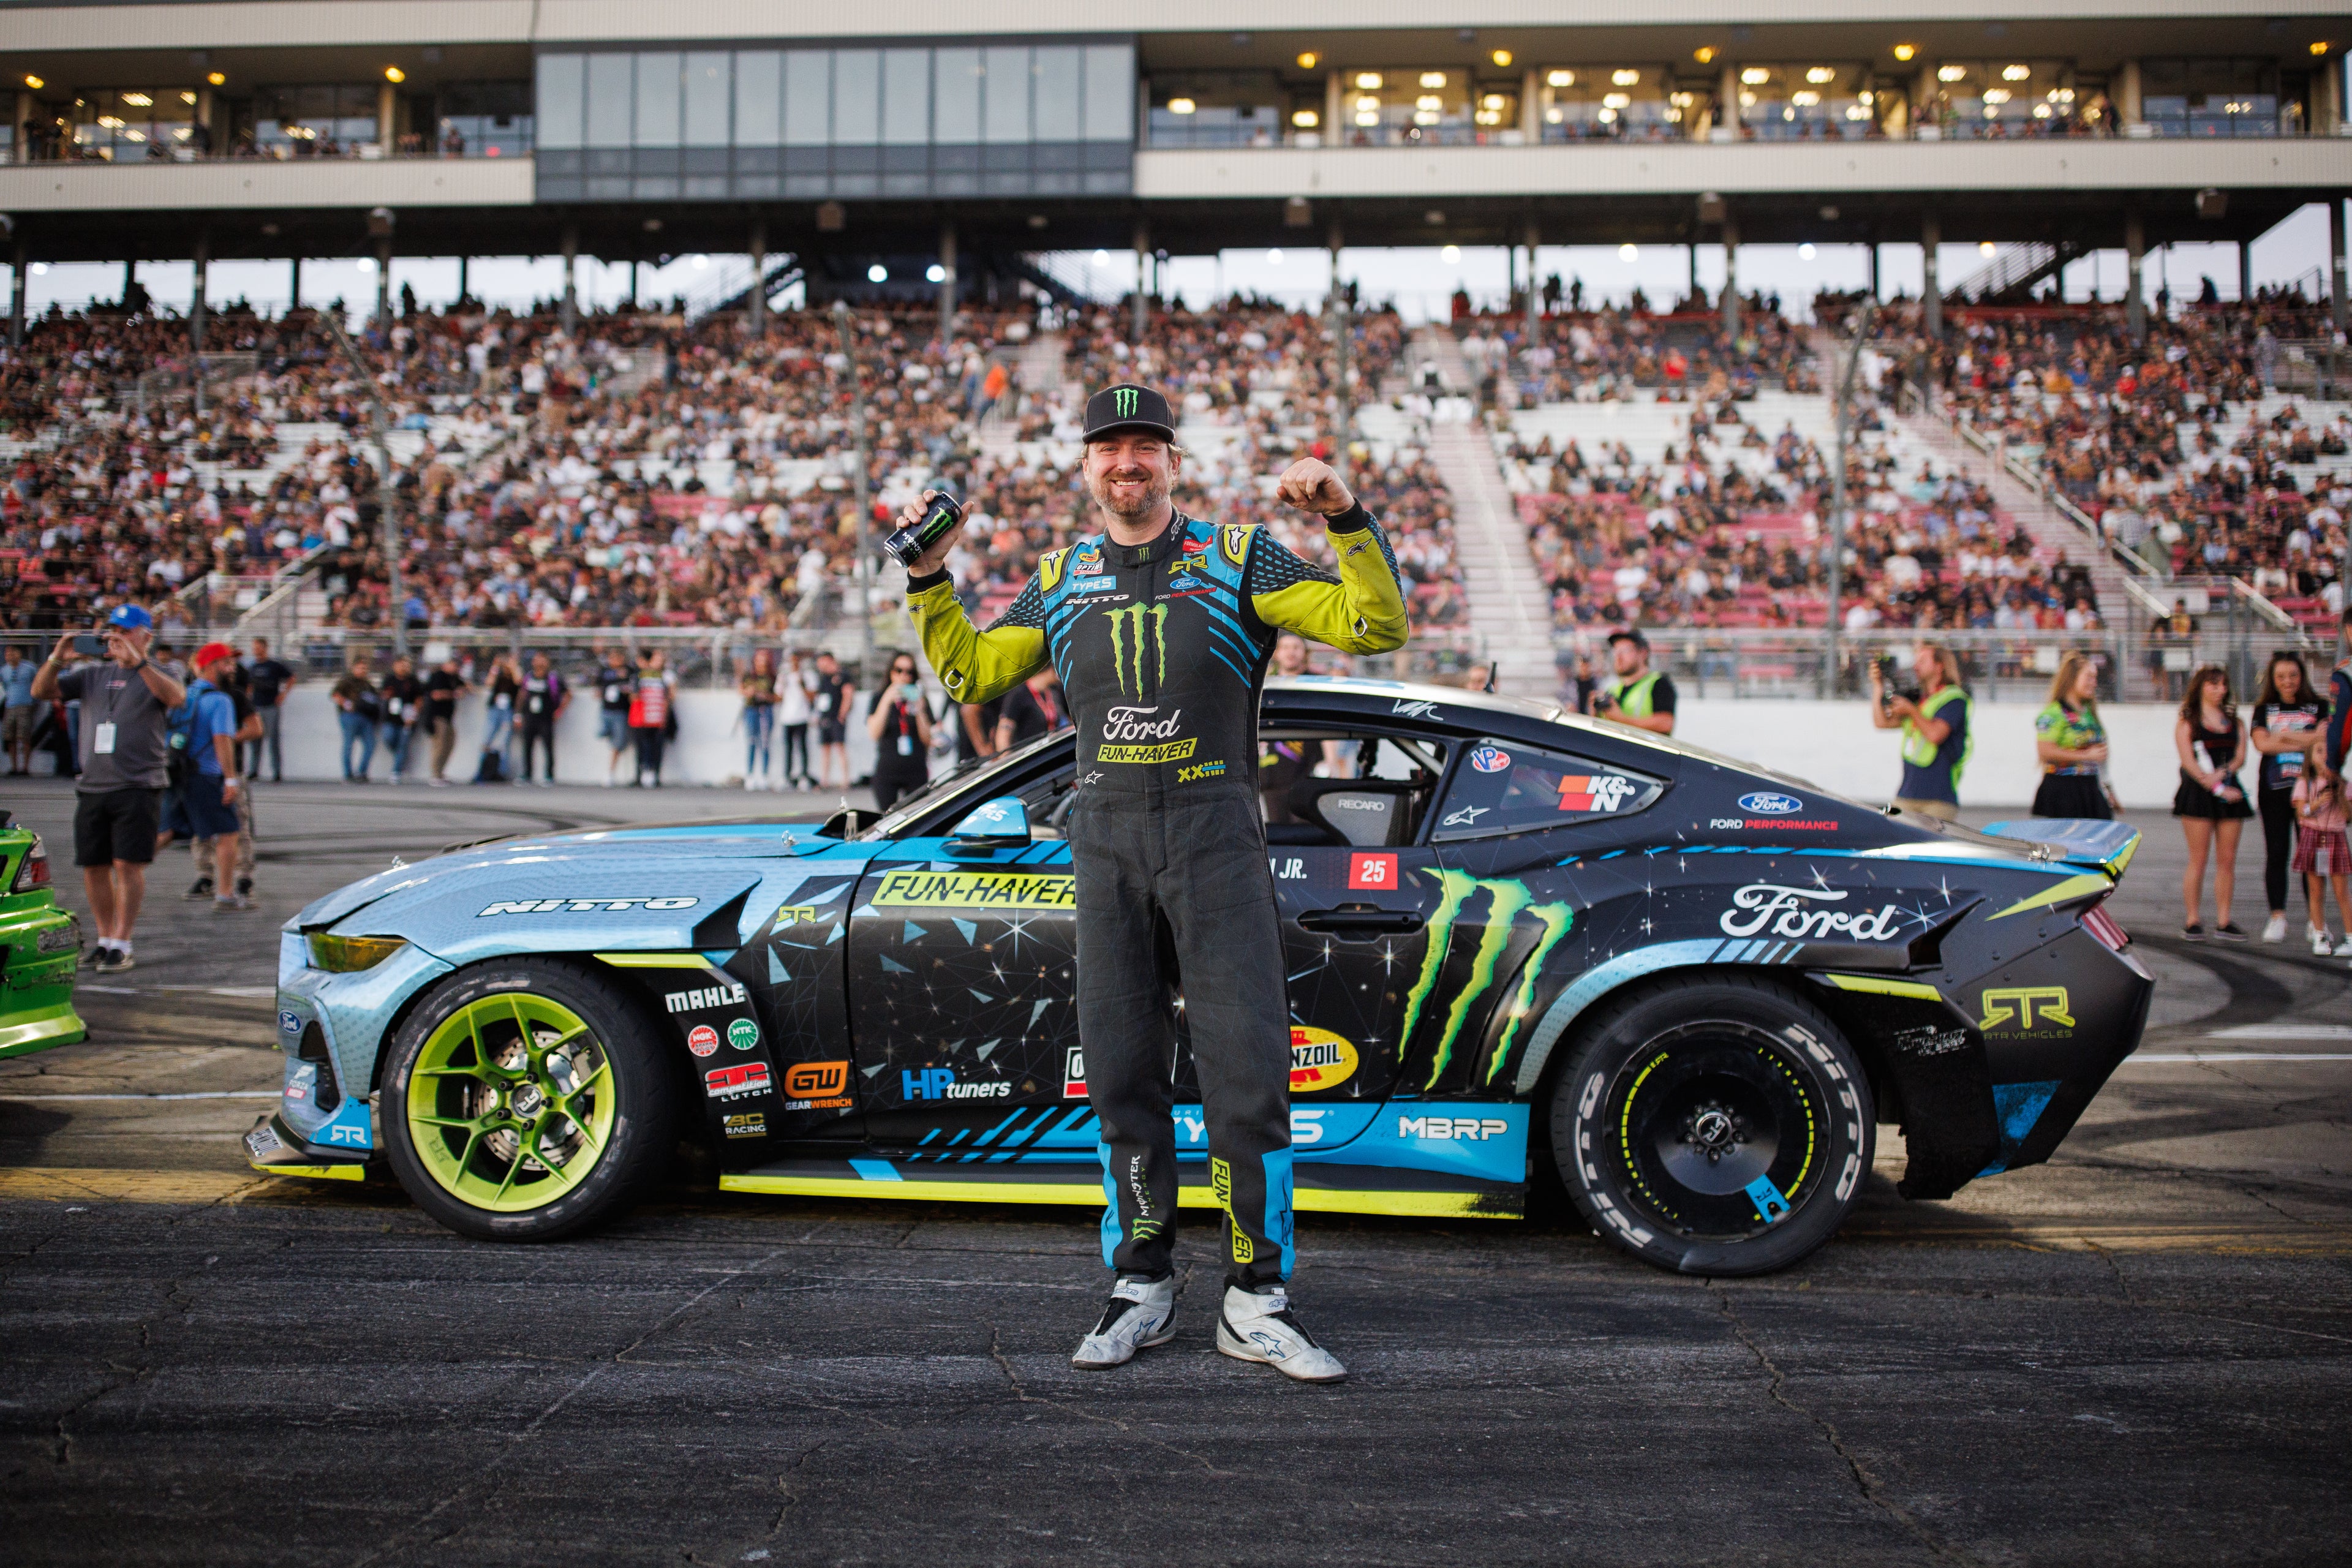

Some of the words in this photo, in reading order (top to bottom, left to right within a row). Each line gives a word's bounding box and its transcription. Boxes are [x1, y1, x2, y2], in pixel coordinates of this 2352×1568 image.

[1176, 579, 1195, 587] Ford
[1066, 594, 1129, 605] NITTO
[1171, 587, 1217, 598] PERFORMANCE
[1103, 706, 1181, 740] Ford
[1099, 741, 1193, 762] FUN-HAVER
[1471, 747, 1498, 771] VP
[1338, 799, 1385, 812] RECARO
[1751, 796, 1790, 810] Ford
[1710, 819, 1743, 829] FORD
[1746, 819, 1838, 831] PERFORMANCE
[1279, 858, 1308, 879] JR.
[1360, 860, 1387, 883] 25
[477, 897, 701, 918] NITTO
[1719, 884, 1900, 941] Ford
[665, 982, 746, 1013] MAHLE
[693, 1032, 713, 1042] NGK
[733, 1026, 752, 1036] NTK
[2011, 1029, 2073, 1041] VEHICLES
[1291, 1043, 1343, 1068] NZOIL
[725, 1125, 766, 1134] RACING
[1399, 1117, 1508, 1141] MBRP
